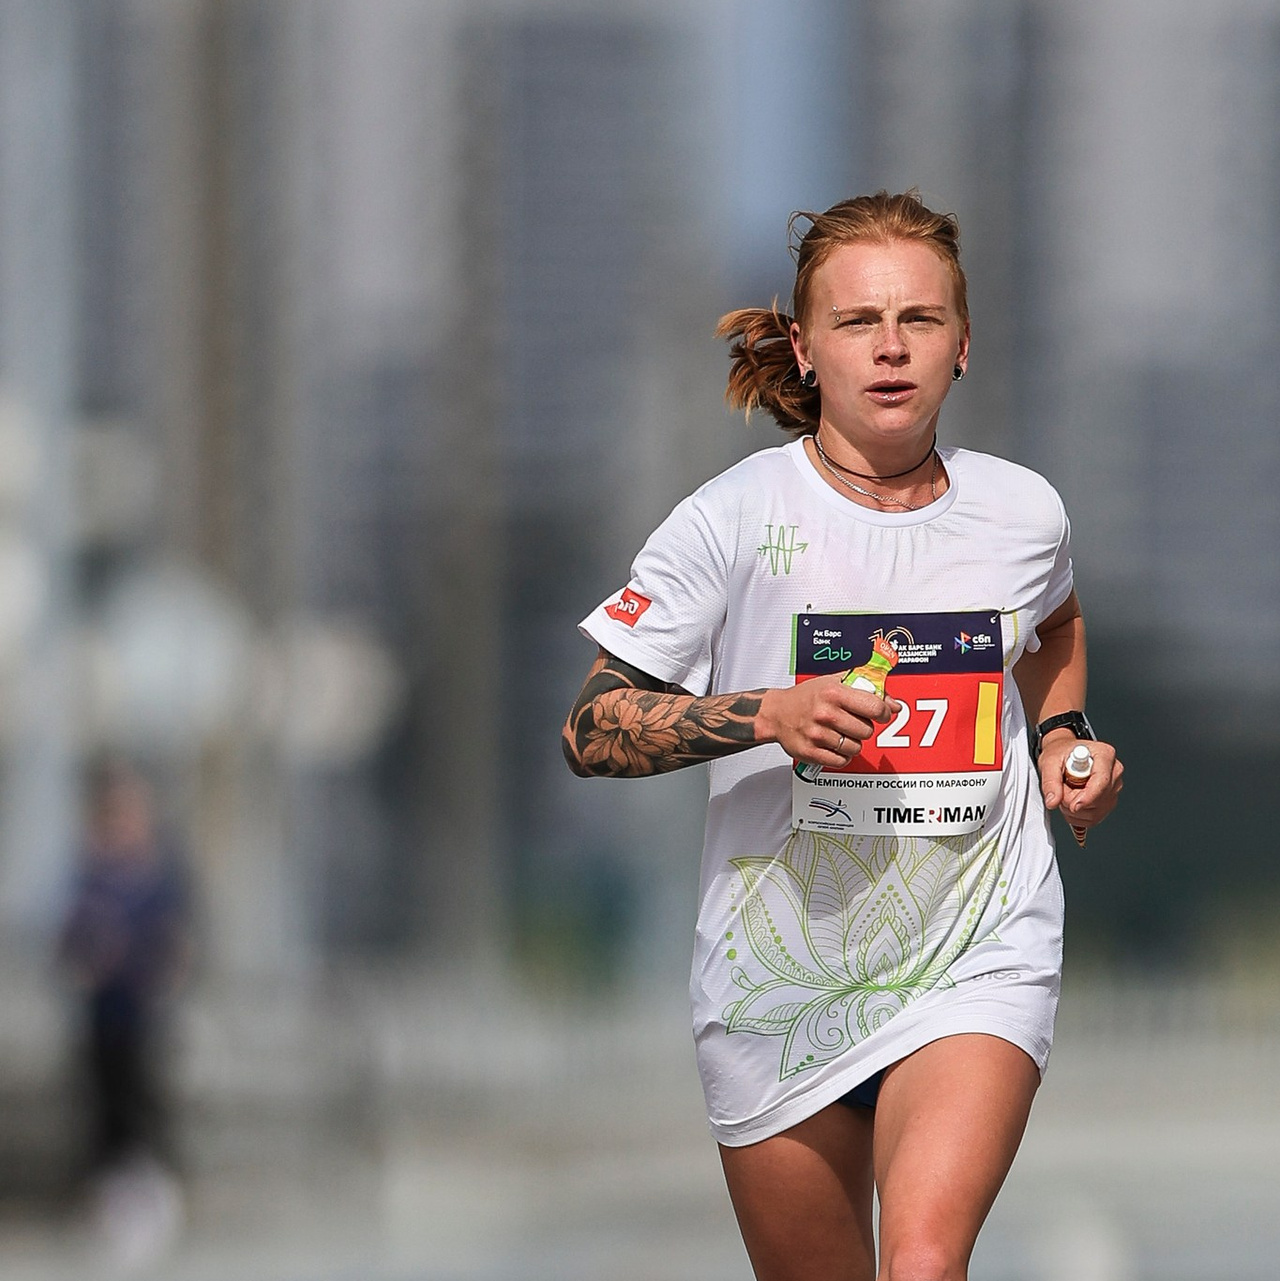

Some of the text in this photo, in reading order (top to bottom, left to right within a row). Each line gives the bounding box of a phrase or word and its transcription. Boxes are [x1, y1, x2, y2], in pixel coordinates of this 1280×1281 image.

[876, 699, 948, 747] 27
[876, 780, 917, 789] РОССИИ
[919, 780, 934, 788] ПО
[936, 778, 987, 788] МАРАФОНУ
